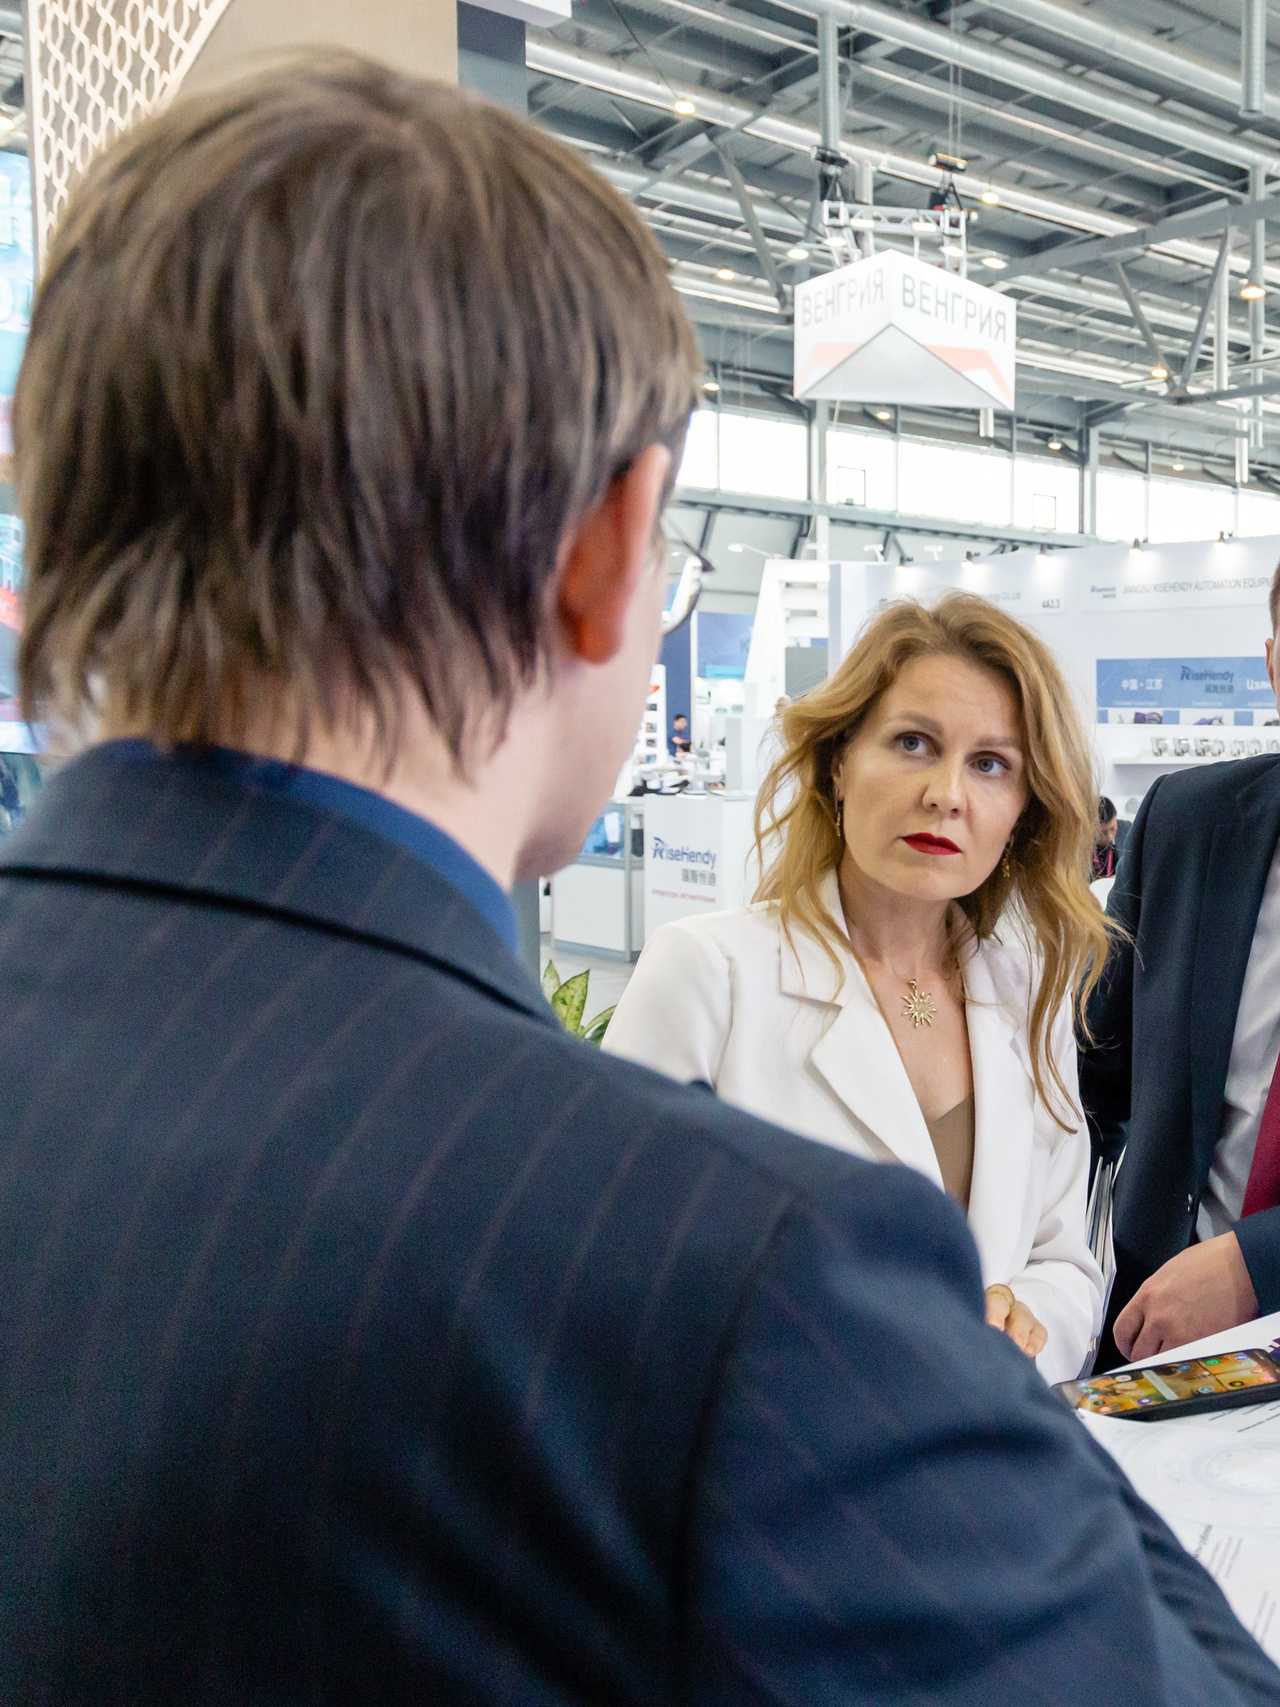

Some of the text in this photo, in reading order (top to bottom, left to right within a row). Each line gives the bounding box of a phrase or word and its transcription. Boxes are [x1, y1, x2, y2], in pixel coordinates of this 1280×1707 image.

[802, 268, 884, 328] ВЕНГРИЯ
[902, 273, 1007, 343] ВЕНГРИЯ
[1194, 579, 1241, 591] AUTOMATION
